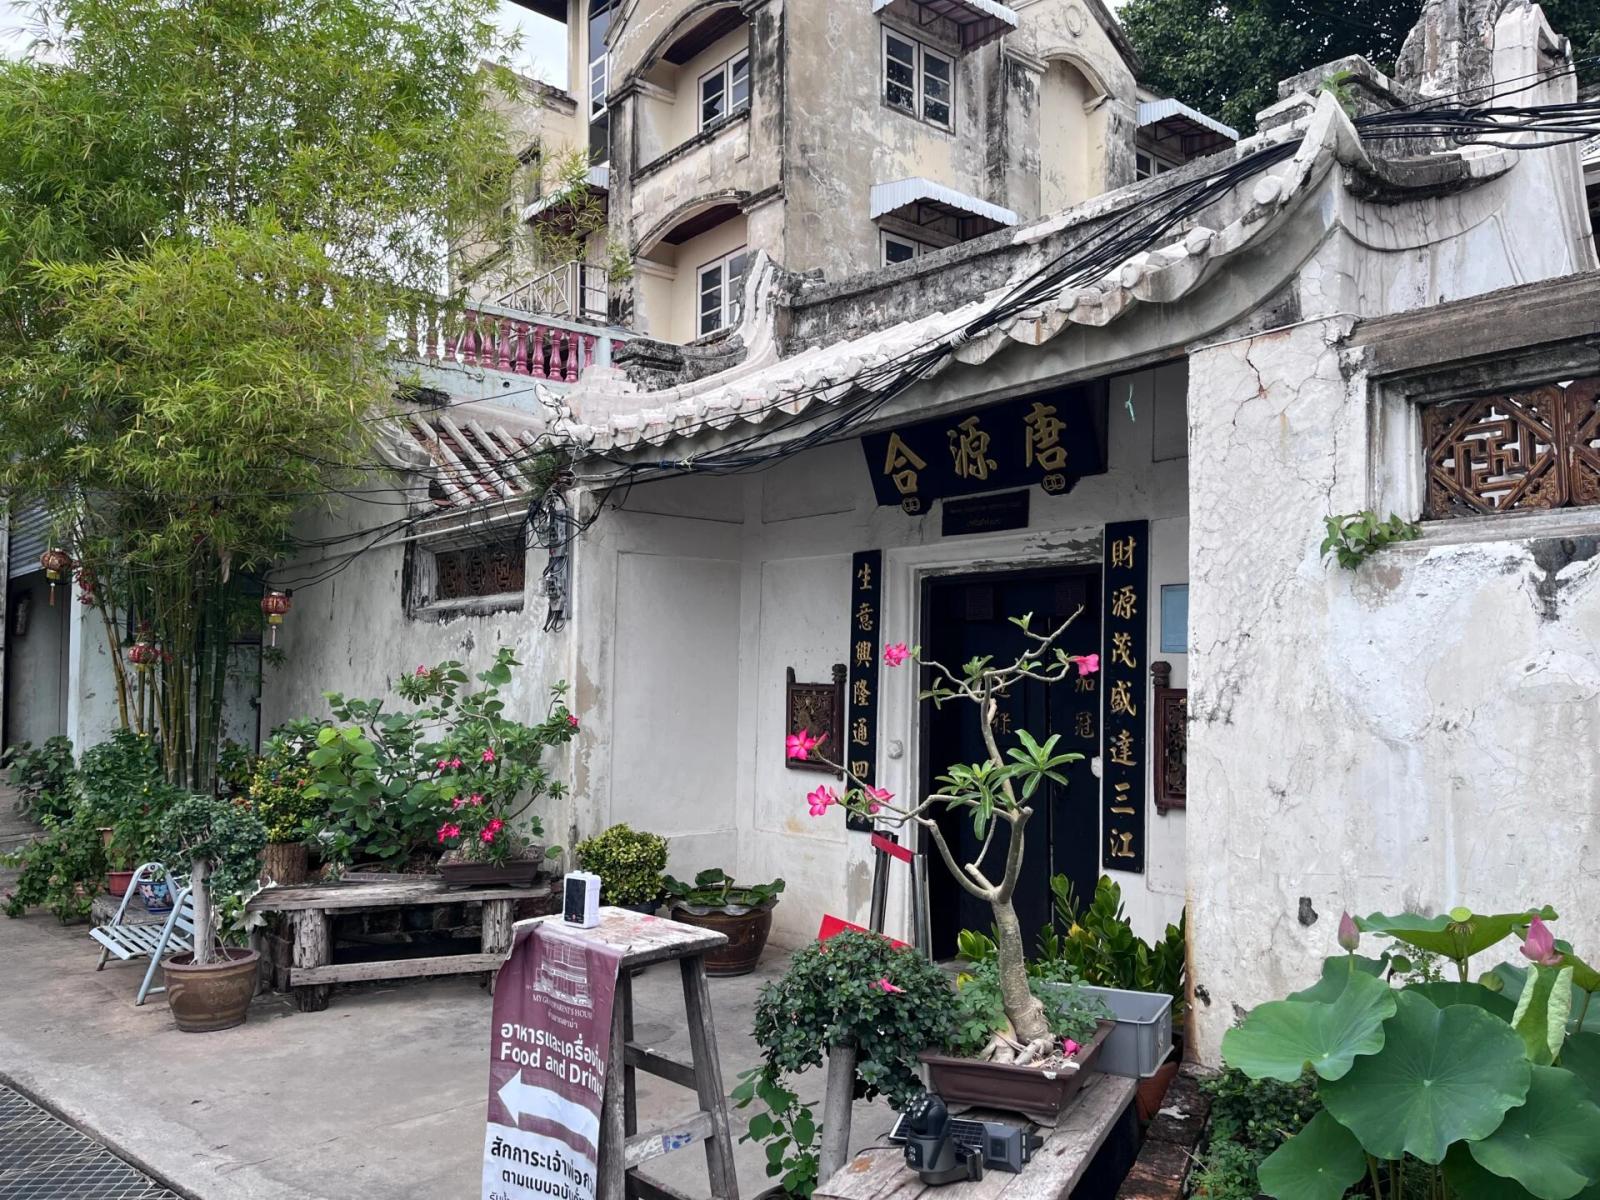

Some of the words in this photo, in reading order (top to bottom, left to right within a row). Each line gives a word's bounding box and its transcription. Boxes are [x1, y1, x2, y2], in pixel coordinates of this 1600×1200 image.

[852, 562, 874, 823] 生意興隆通四
[532, 994, 542, 1002] MY
[500, 1042, 541, 1068] Food
[545, 1055, 566, 1080] and
